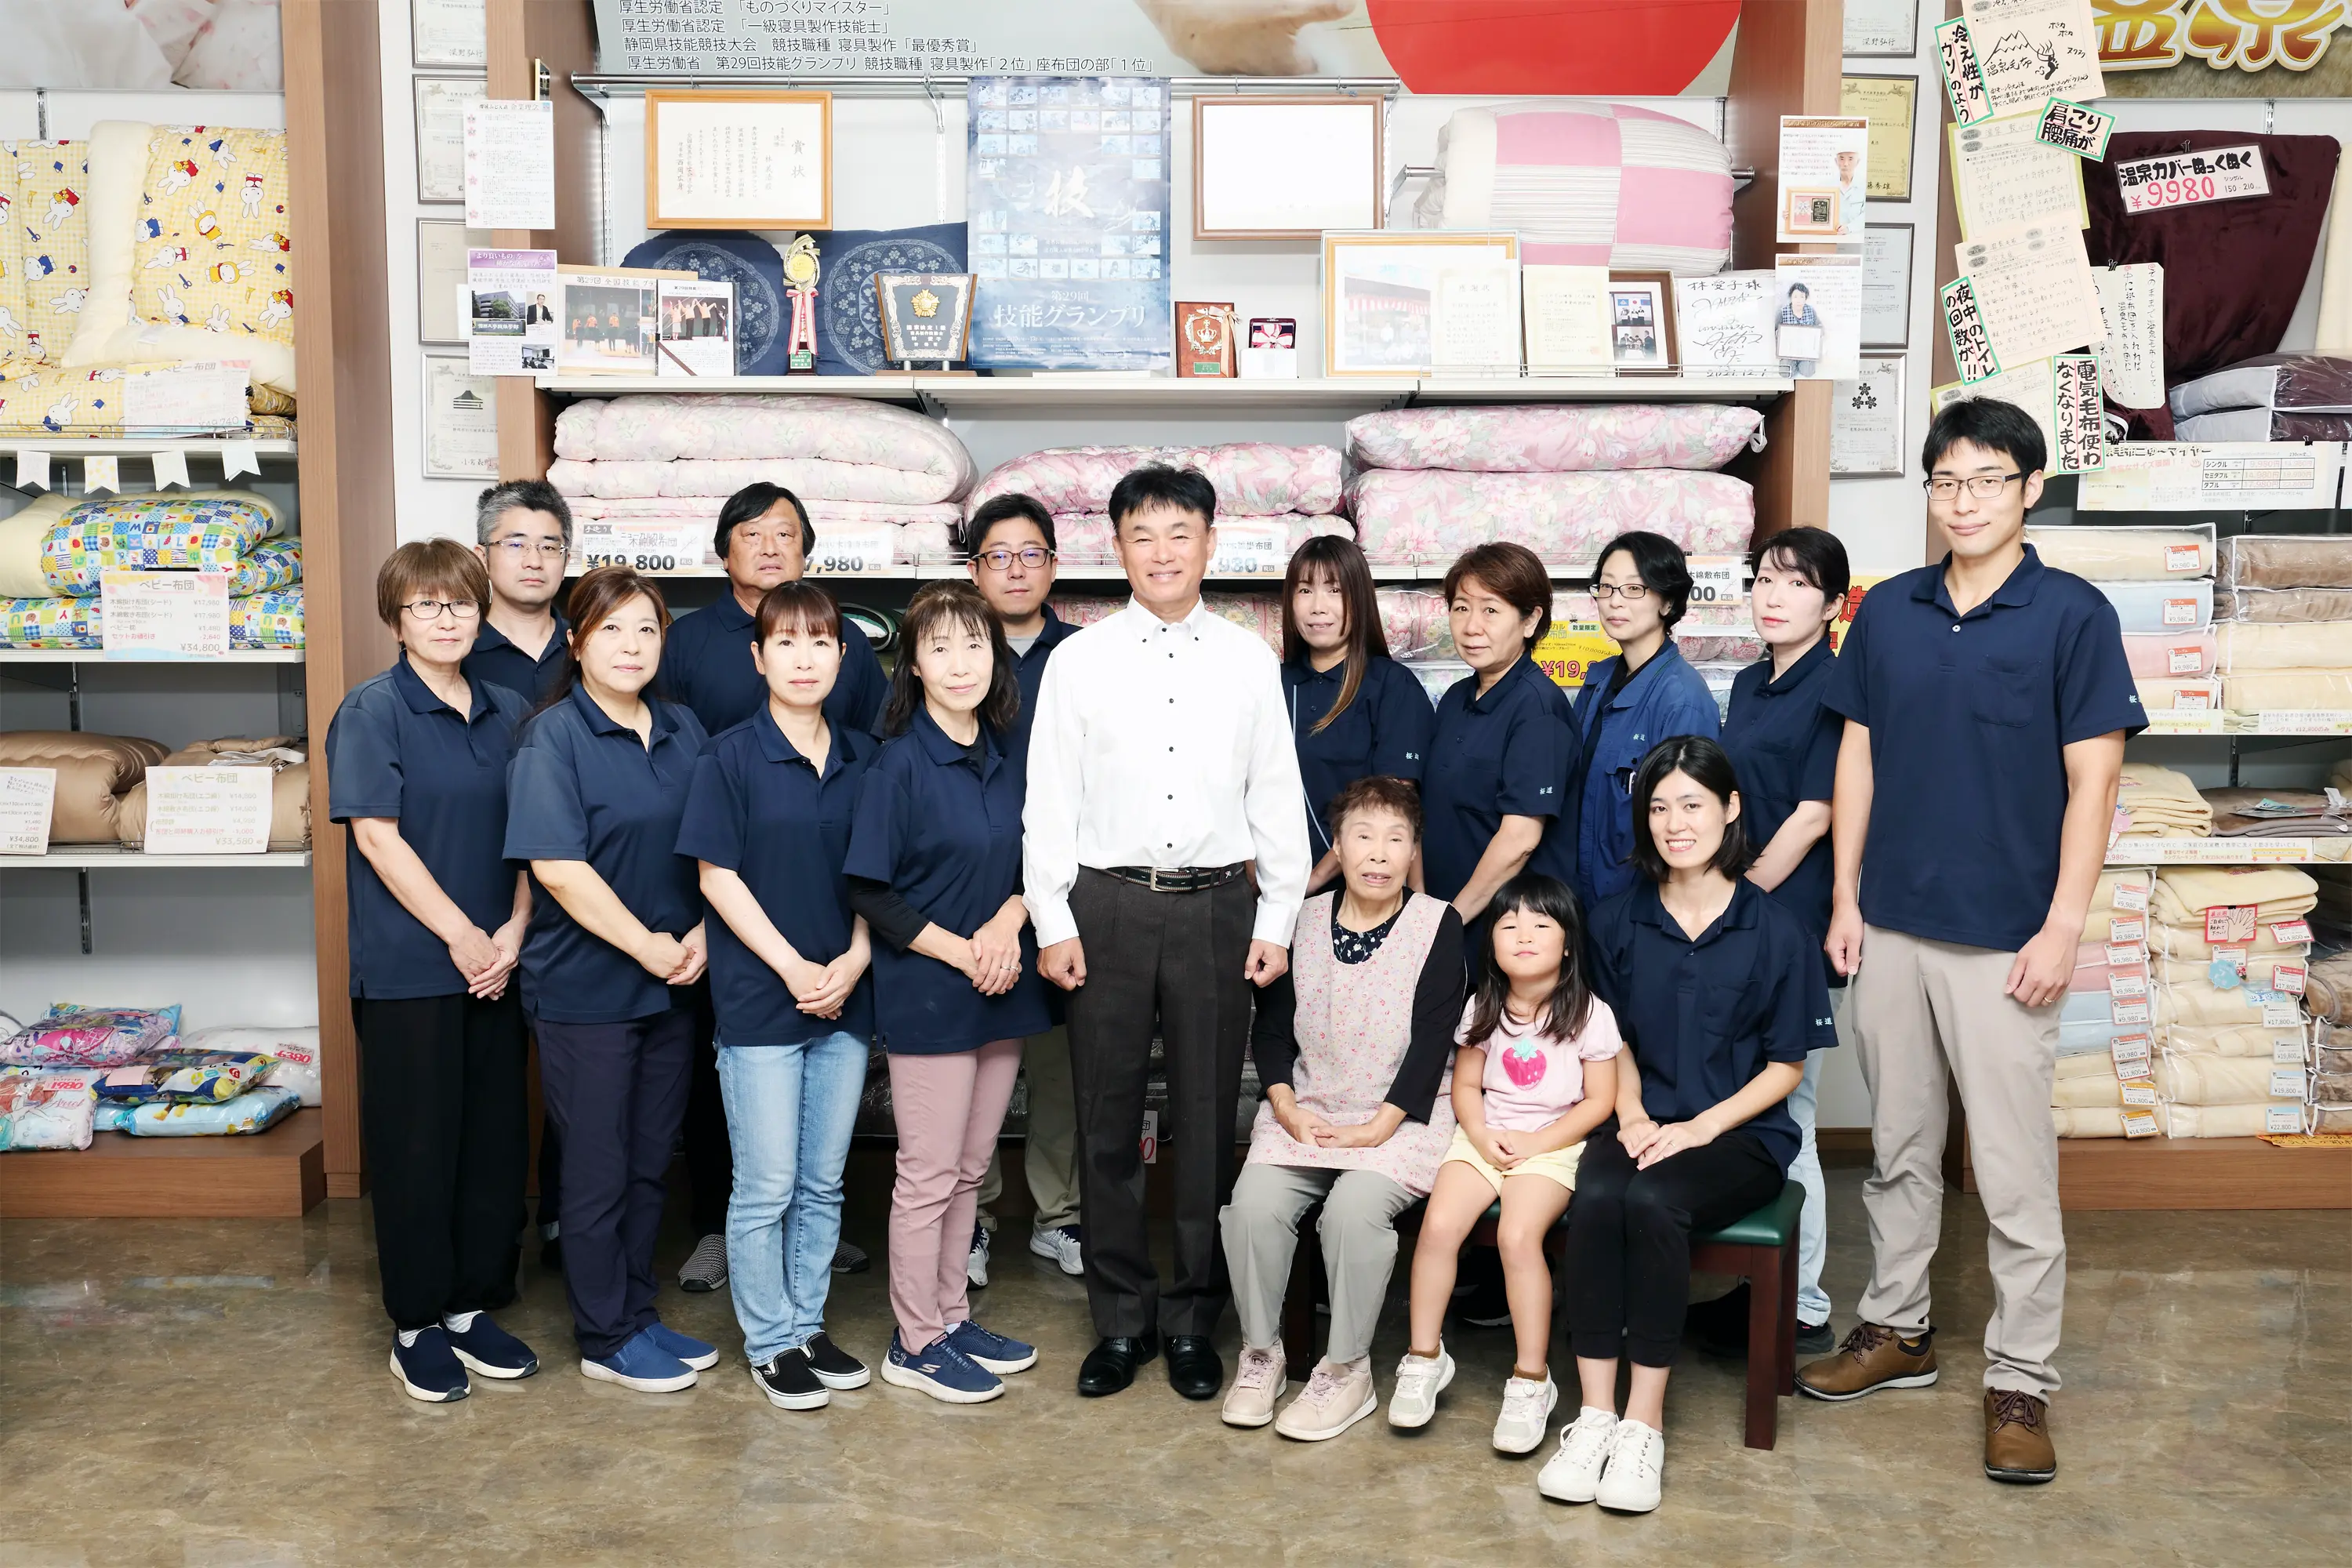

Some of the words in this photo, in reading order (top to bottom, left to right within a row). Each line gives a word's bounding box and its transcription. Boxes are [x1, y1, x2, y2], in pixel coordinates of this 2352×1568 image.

[619, 0, 724, 14] 厚生労働省認定
[622, 19, 725, 33] 厚生労働省認定
[740, 19, 888, 34] 「一級寝具製作技能士」
[624, 38, 757, 53] 静岡県技能競技大会
[772, 38, 831, 53] 競技職種
[838, 38, 977, 53] 寝具製作「最優秀賞」
[628, 56, 700, 71] 厚生労働省
[715, 56, 857, 71] 第29回技能グランプリ
[865, 56, 924, 71] 競技職種
[1951, 24, 1984, 100] 冷え性が
[1986, 56, 2033, 78] 温泉毛布
[2045, 102, 2102, 134] 肩こり
[577, 275, 601, 285] 第29回
[1051, 290, 1089, 301] 第29回
[993, 304, 1145, 328] 技能グランプリ
[1956, 283, 1998, 377] 夜中のトイレ
[2056, 361, 2080, 470] なくなりました
[140, 579, 194, 591] ベビー布団
[180, 643, 220, 652] ¥34,800
[1541, 660, 1599, 681] ¥19,
[181, 772, 238, 784] ベビー布団
[215, 837, 254, 846] ¥33,580
[2117, 901, 2136, 909] ¥9,980
[2115, 932, 2135, 941] ¥9,980
